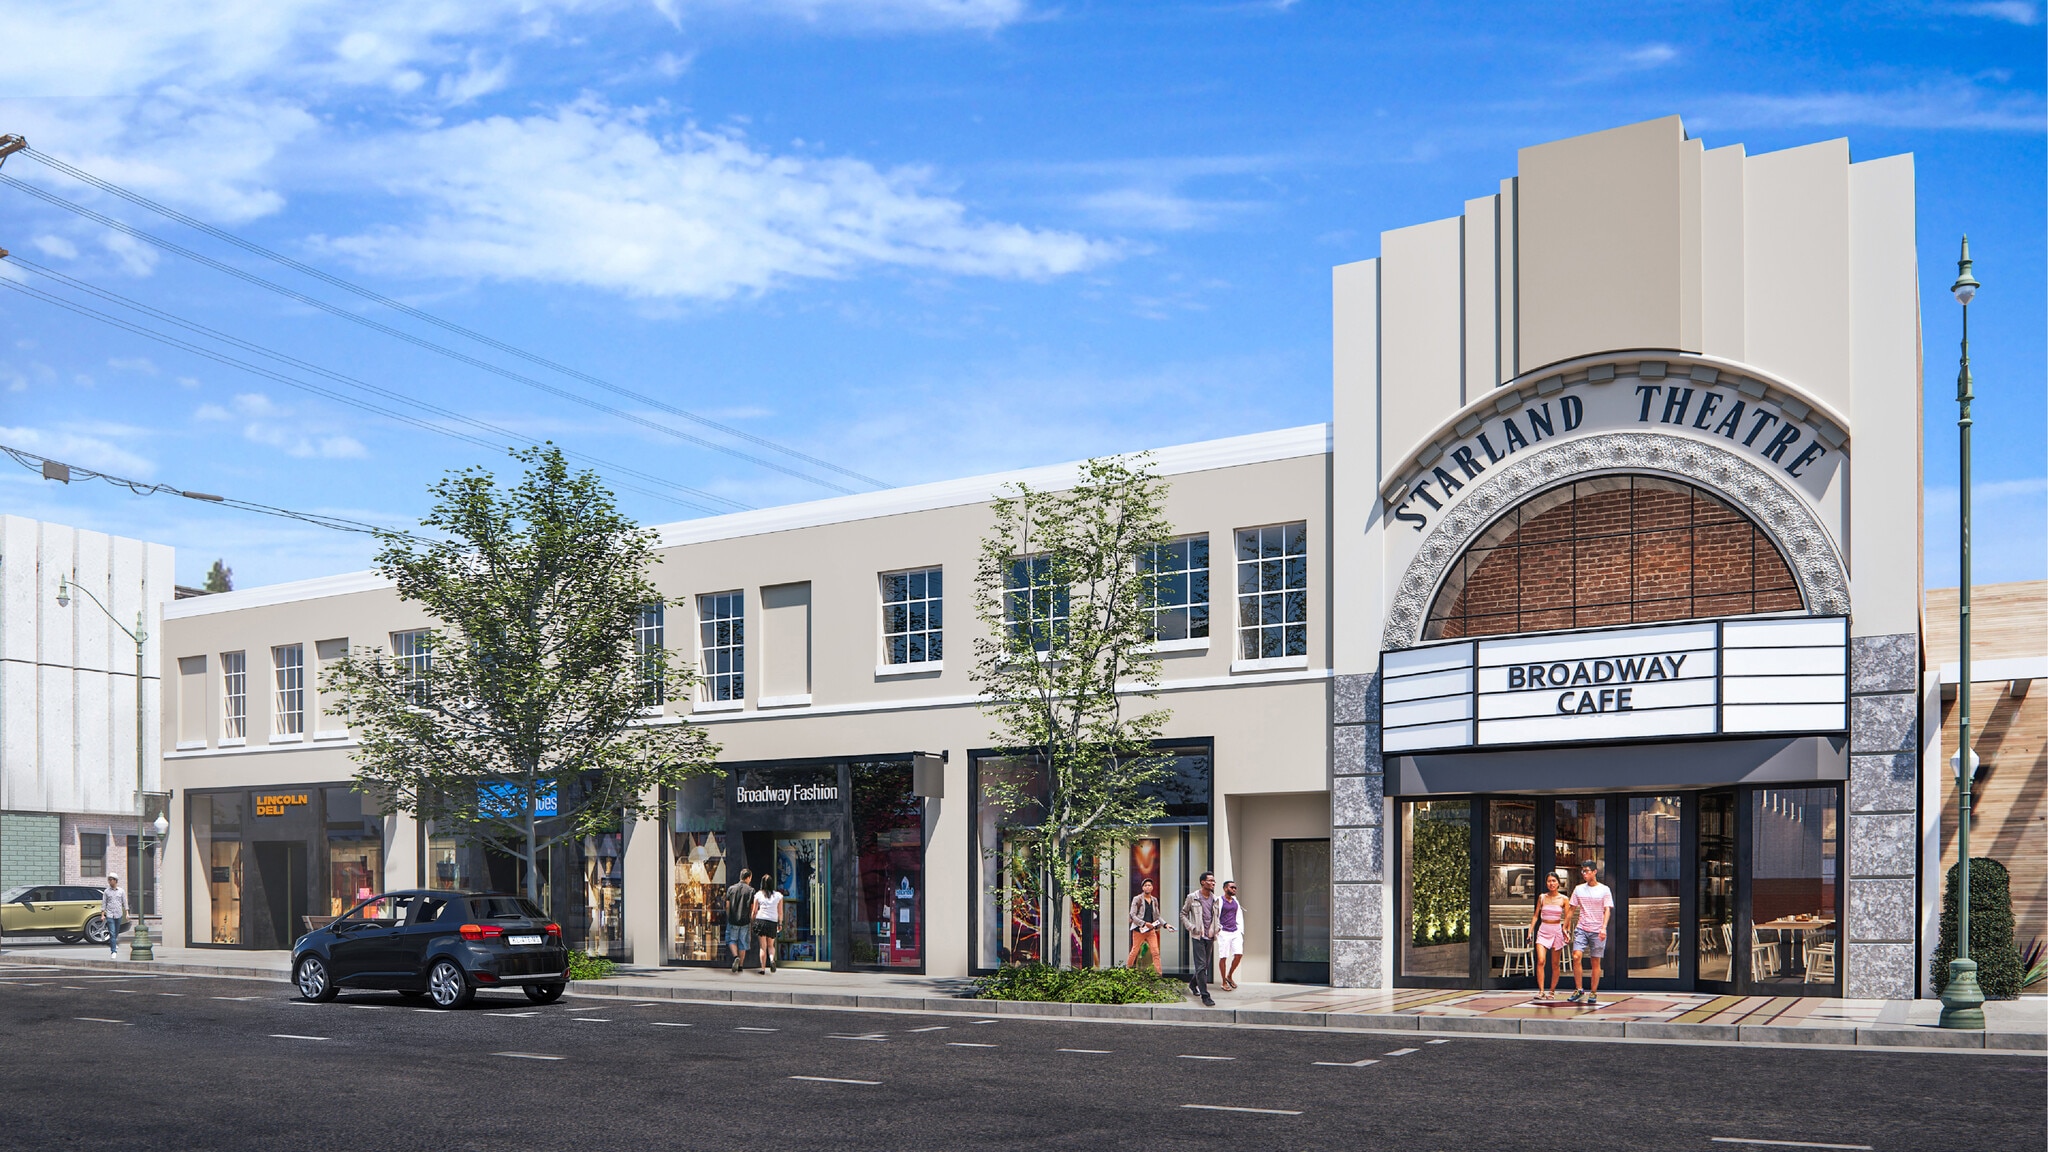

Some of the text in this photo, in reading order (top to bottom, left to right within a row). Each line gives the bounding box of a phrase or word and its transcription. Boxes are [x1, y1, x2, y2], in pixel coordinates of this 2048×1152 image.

[1395, 385, 1827, 532] STARLAND THEATRE
[1508, 655, 1687, 689] BROADWAY
[1557, 688, 1633, 714] CAFE
[256, 794, 308, 805] LINCOLN
[737, 783, 838, 805] Broadway Fashion
[256, 805, 285, 816] DELI
